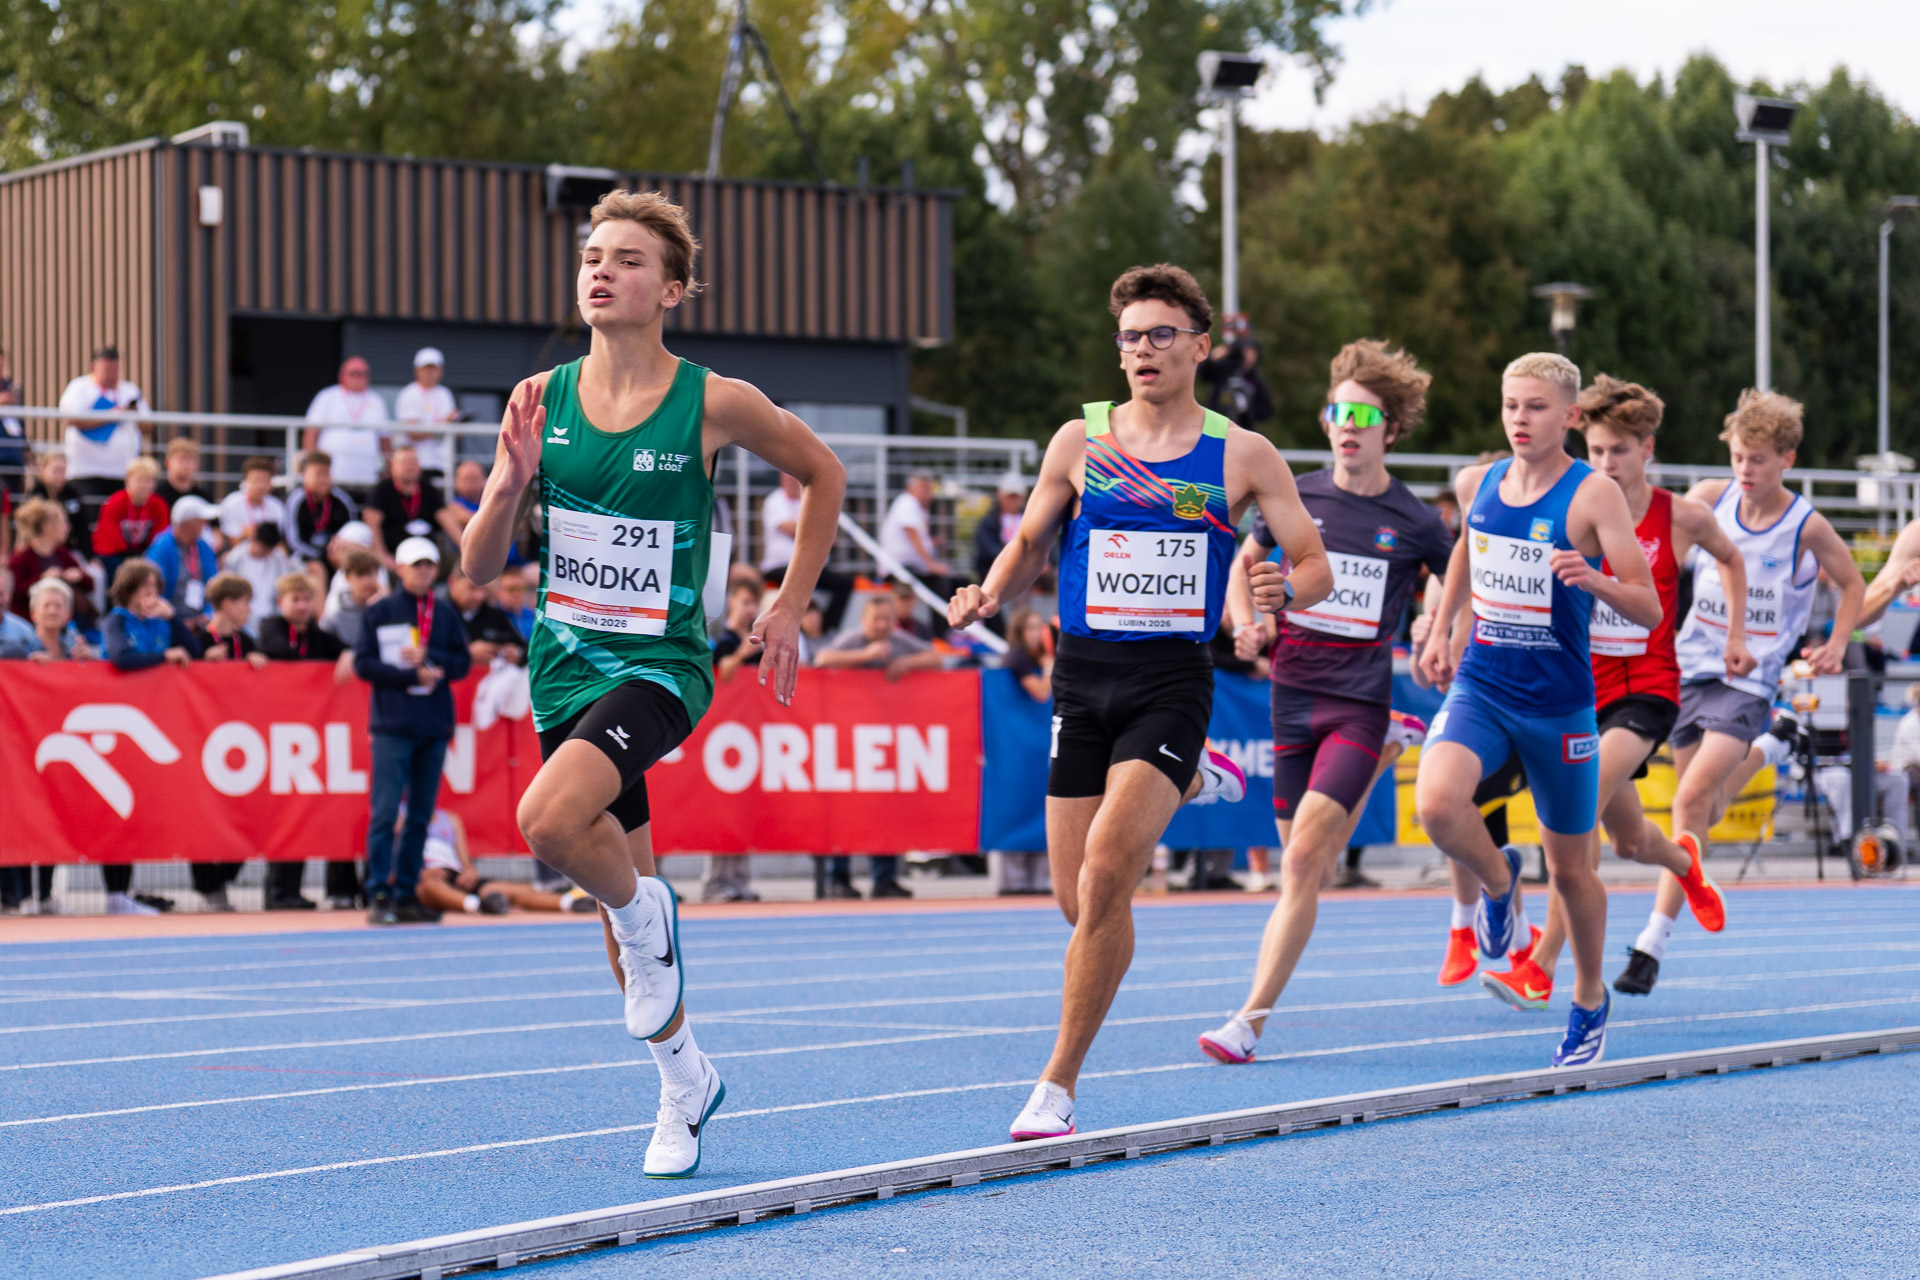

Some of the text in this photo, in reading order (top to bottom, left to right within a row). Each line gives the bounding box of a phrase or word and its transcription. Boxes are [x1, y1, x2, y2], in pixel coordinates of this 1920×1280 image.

[611, 524, 660, 549] 291
[1103, 551, 1131, 559] ORLEN
[1156, 539, 1196, 557] 175
[1509, 544, 1543, 563] 789
[555, 554, 661, 593] BRÓDKA
[1340, 560, 1383, 579] 1166
[1096, 572, 1196, 595] WOZICH
[572, 612, 627, 628] LUBIN 2026
[1118, 619, 1172, 628] LUBIN 2026
[201, 720, 476, 796] ORLN
[703, 720, 949, 793] ORLEN
